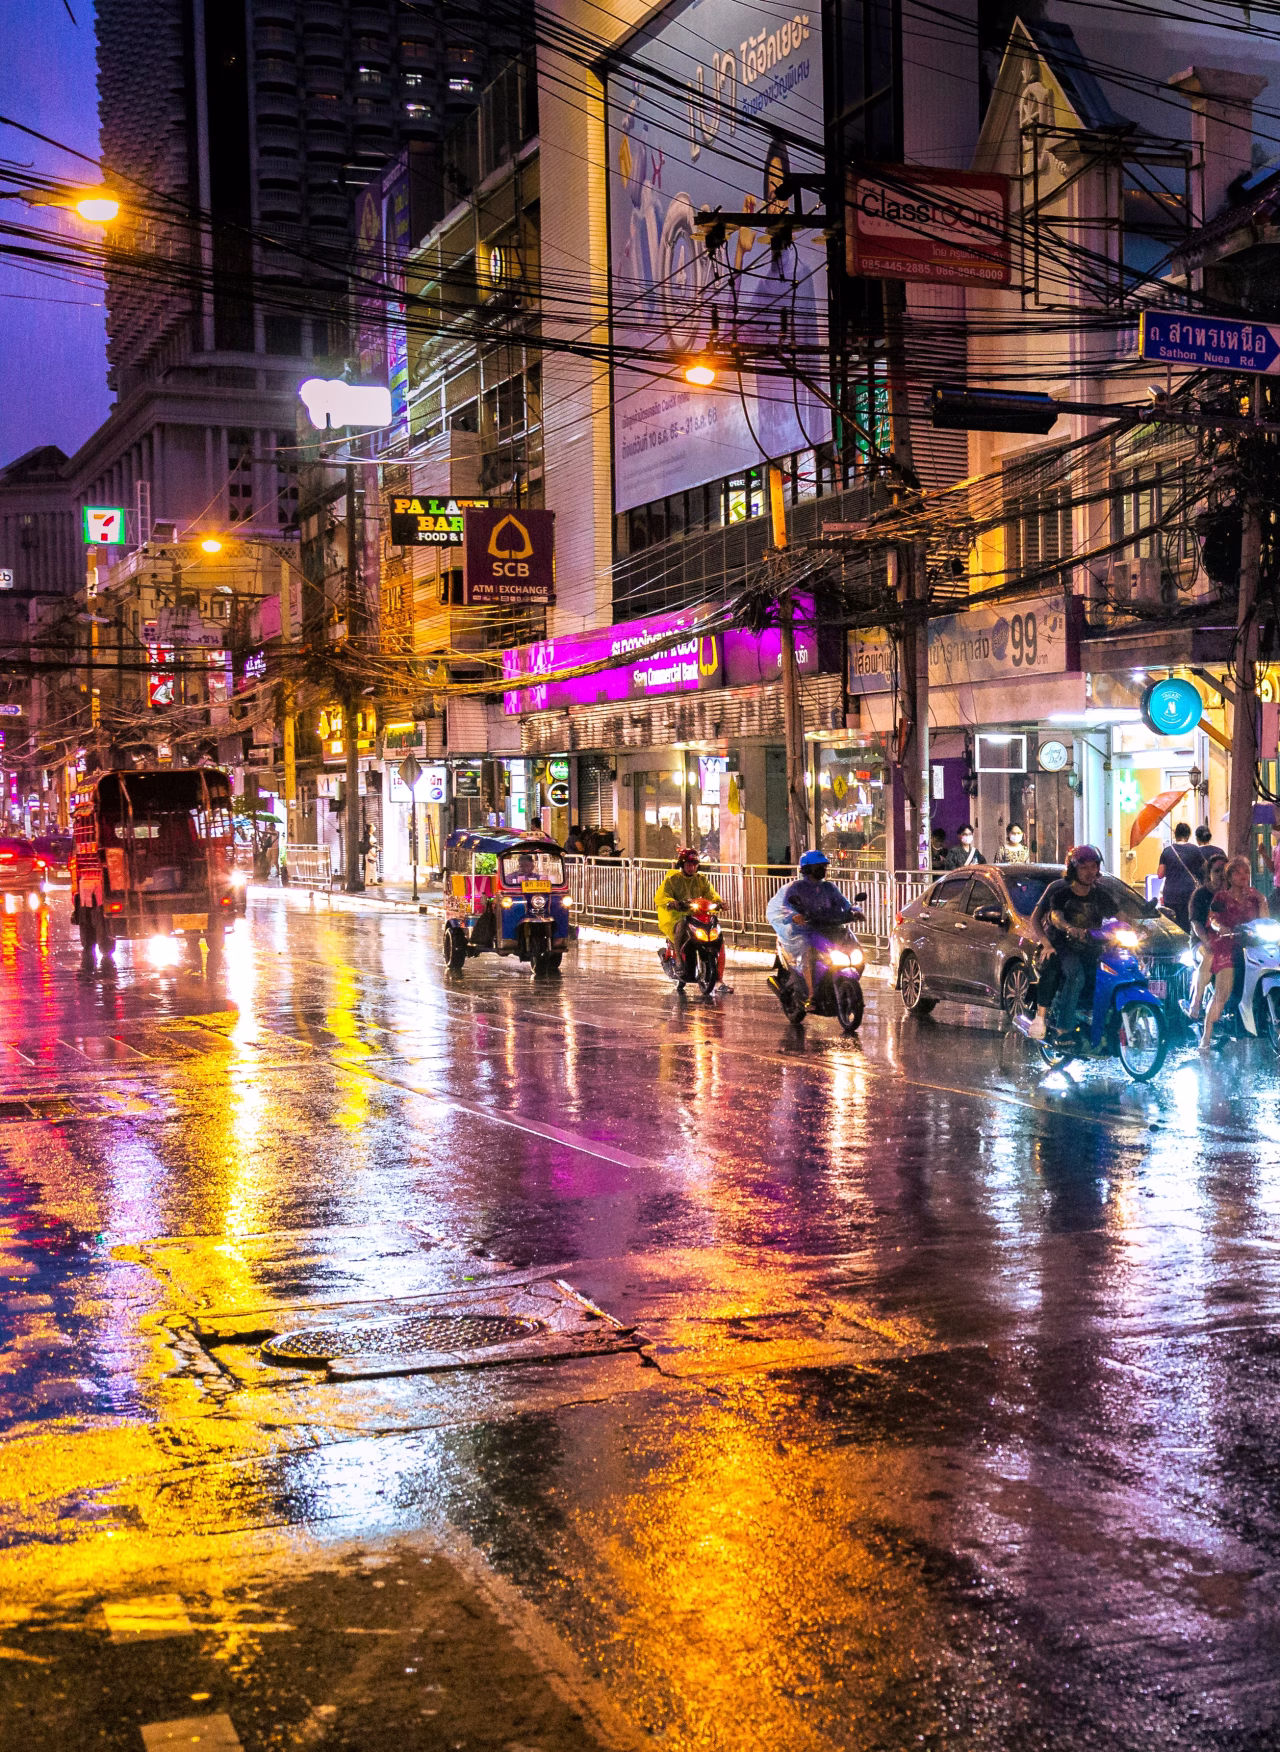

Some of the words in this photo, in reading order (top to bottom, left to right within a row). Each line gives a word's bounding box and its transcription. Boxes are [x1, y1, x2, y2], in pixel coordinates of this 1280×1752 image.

[861, 188, 1000, 230] Classroom
[1150, 326, 1164, 341] ถ.
[1169, 322, 1267, 354] สาทรเหนือ
[1159, 346, 1197, 360] Sathon
[1204, 352, 1230, 364] Nuea
[1240, 356, 1256, 367] Rd.
[393, 499, 425, 515] PA
[417, 516, 464, 532] BAR
[417, 532, 448, 542] FOOD
[492, 562, 530, 577] SCB
[472, 584, 494, 593] ATM
[499, 585, 548, 595] EXCHANGE
[1011, 611, 1038, 668] 99
